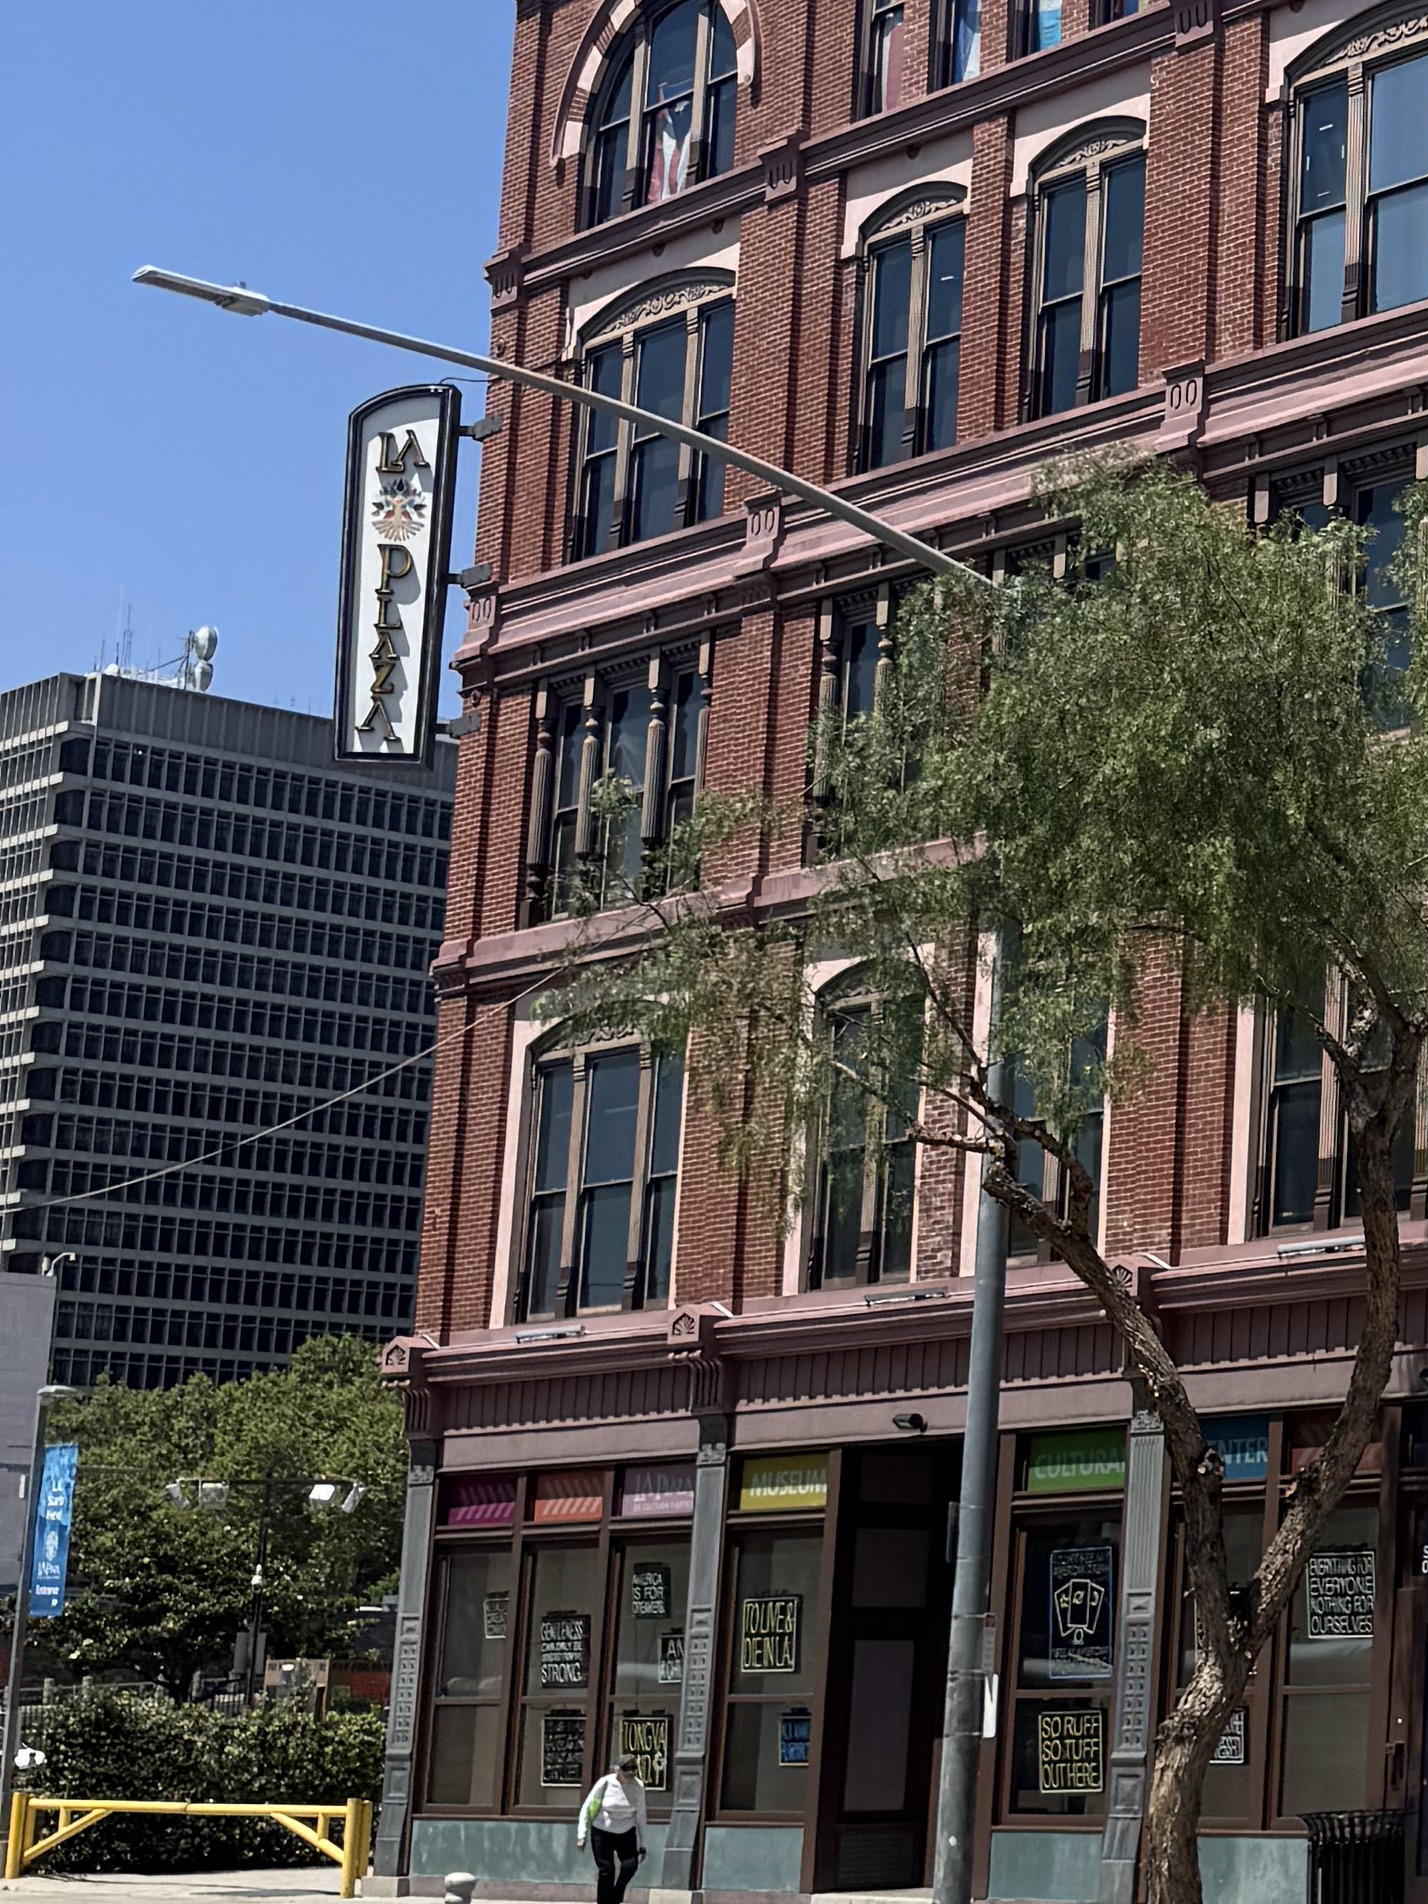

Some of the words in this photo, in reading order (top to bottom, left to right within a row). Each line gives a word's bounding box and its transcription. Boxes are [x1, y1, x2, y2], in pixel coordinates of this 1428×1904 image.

[376, 429, 430, 473] LA
[355, 543, 413, 741] PLAZA
[749, 1467, 827, 1498] MUSEUM
[1310, 1576, 1373, 1595] EVERYONE
[745, 1602, 759, 1634] TO
[760, 1601, 785, 1634] LIVE
[1311, 1615, 1373, 1633] OURSELVES
[1042, 1716, 1062, 1738] SO
[1064, 1715, 1100, 1737] RUFF
[1042, 1739, 1062, 1762] SO
[1064, 1738, 1100, 1760] TUFF
